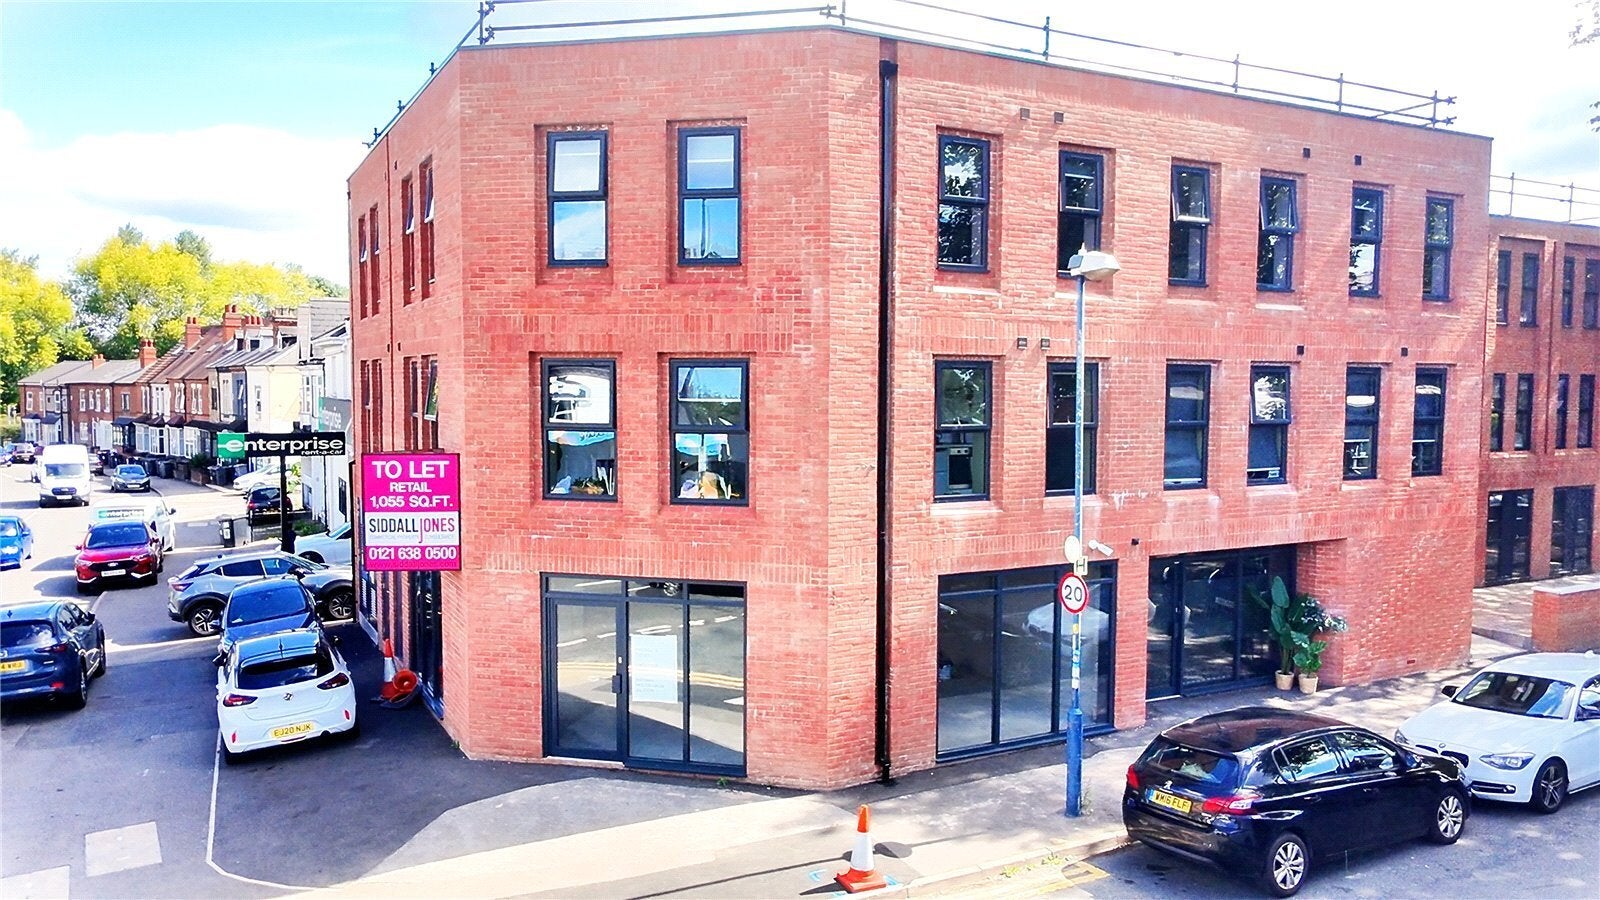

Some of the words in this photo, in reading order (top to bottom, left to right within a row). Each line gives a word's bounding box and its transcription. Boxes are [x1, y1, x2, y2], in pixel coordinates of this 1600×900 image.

[225, 436, 344, 454] enterprise
[371, 460, 403, 479] TO
[409, 460, 450, 479] LET
[389, 481, 432, 493] RETAIL
[370, 495, 405, 509] 1,055
[409, 495, 453, 508] SQ.FT.
[369, 518, 419, 533] SIDDALL
[418, 517, 455, 544] JONES
[368, 547, 395, 560] 0121
[398, 547, 421, 560] 638
[425, 546, 457, 560] 0500
[1075, 558, 1086, 573] H
[1064, 584, 1083, 602] 20
